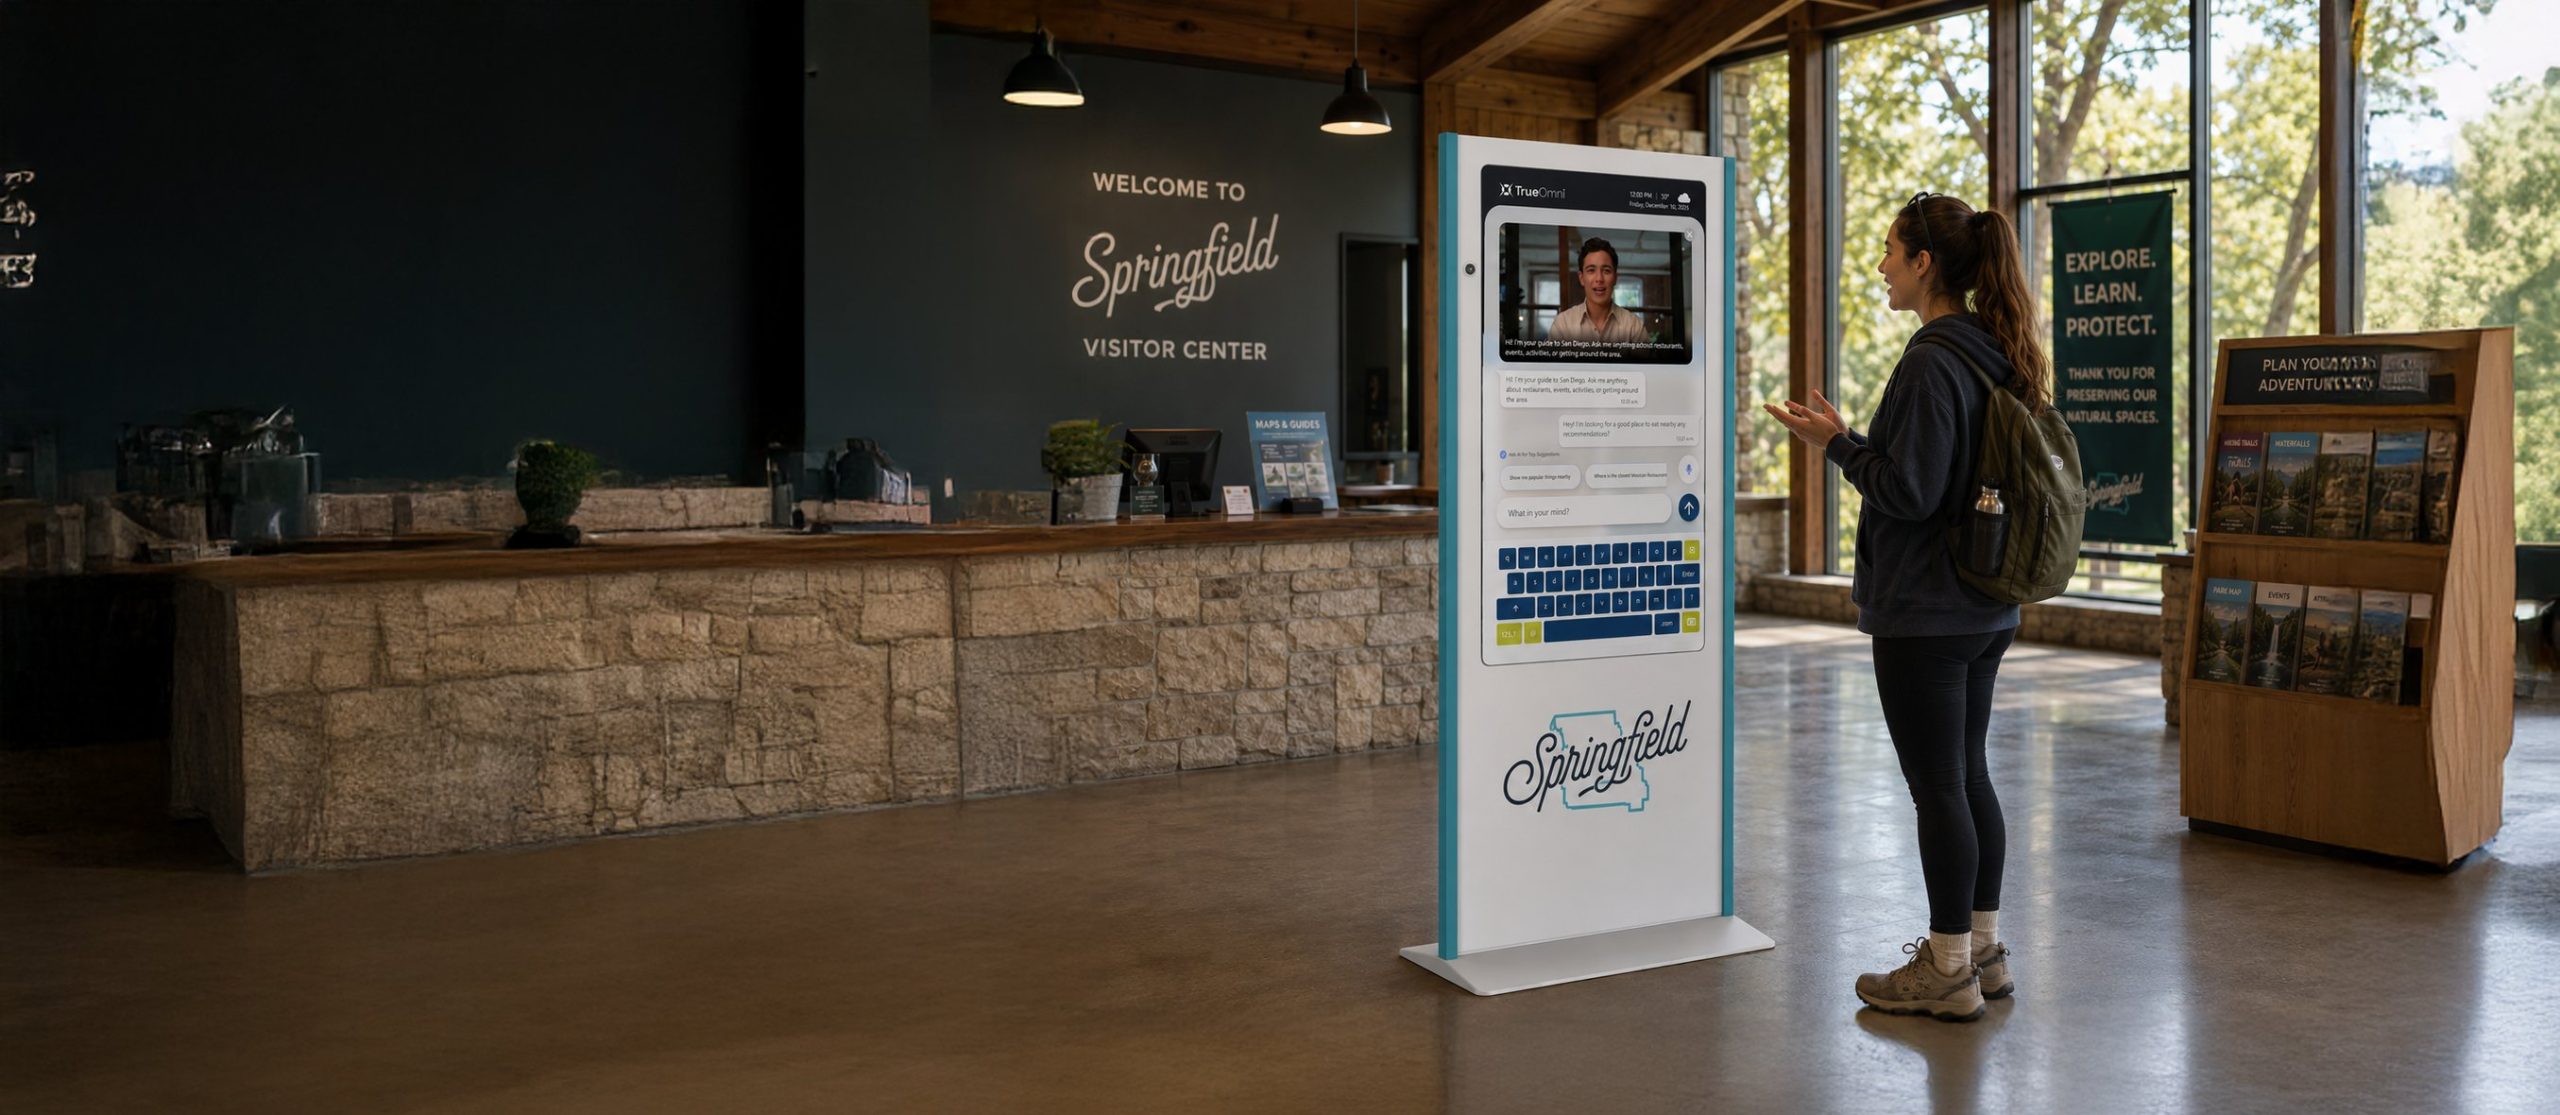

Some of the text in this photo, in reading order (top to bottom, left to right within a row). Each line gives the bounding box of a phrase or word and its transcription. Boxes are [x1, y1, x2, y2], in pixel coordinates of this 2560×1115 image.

[1093, 172, 1246, 202] WELCOME TO
[1514, 185, 1566, 199] TrueOmni
[1071, 213, 1279, 318] Springfield
[2065, 247, 2157, 273] EXPLORE.
[2074, 281, 2143, 305] LEARN.
[2065, 314, 2157, 338] PROTECT.
[1083, 338, 1267, 361] VISITOR CENTER
[2067, 366, 2156, 380] THANK YOU FOR
[2263, 358, 2298, 372] PLAN
[2066, 388, 2157, 402] PRESERVING OUR
[1255, 420, 1321, 429] MAPS & GUIDES
[2066, 410, 2160, 424] NATURAL SPACES.
[2087, 472, 2144, 510] Springfield
[1508, 509, 1525, 517] What
[1534, 510, 1549, 518] your
[1551, 507, 1570, 516] mind?
[2268, 591, 2290, 600] EVENTS
[1503, 699, 1692, 813] Springfield
